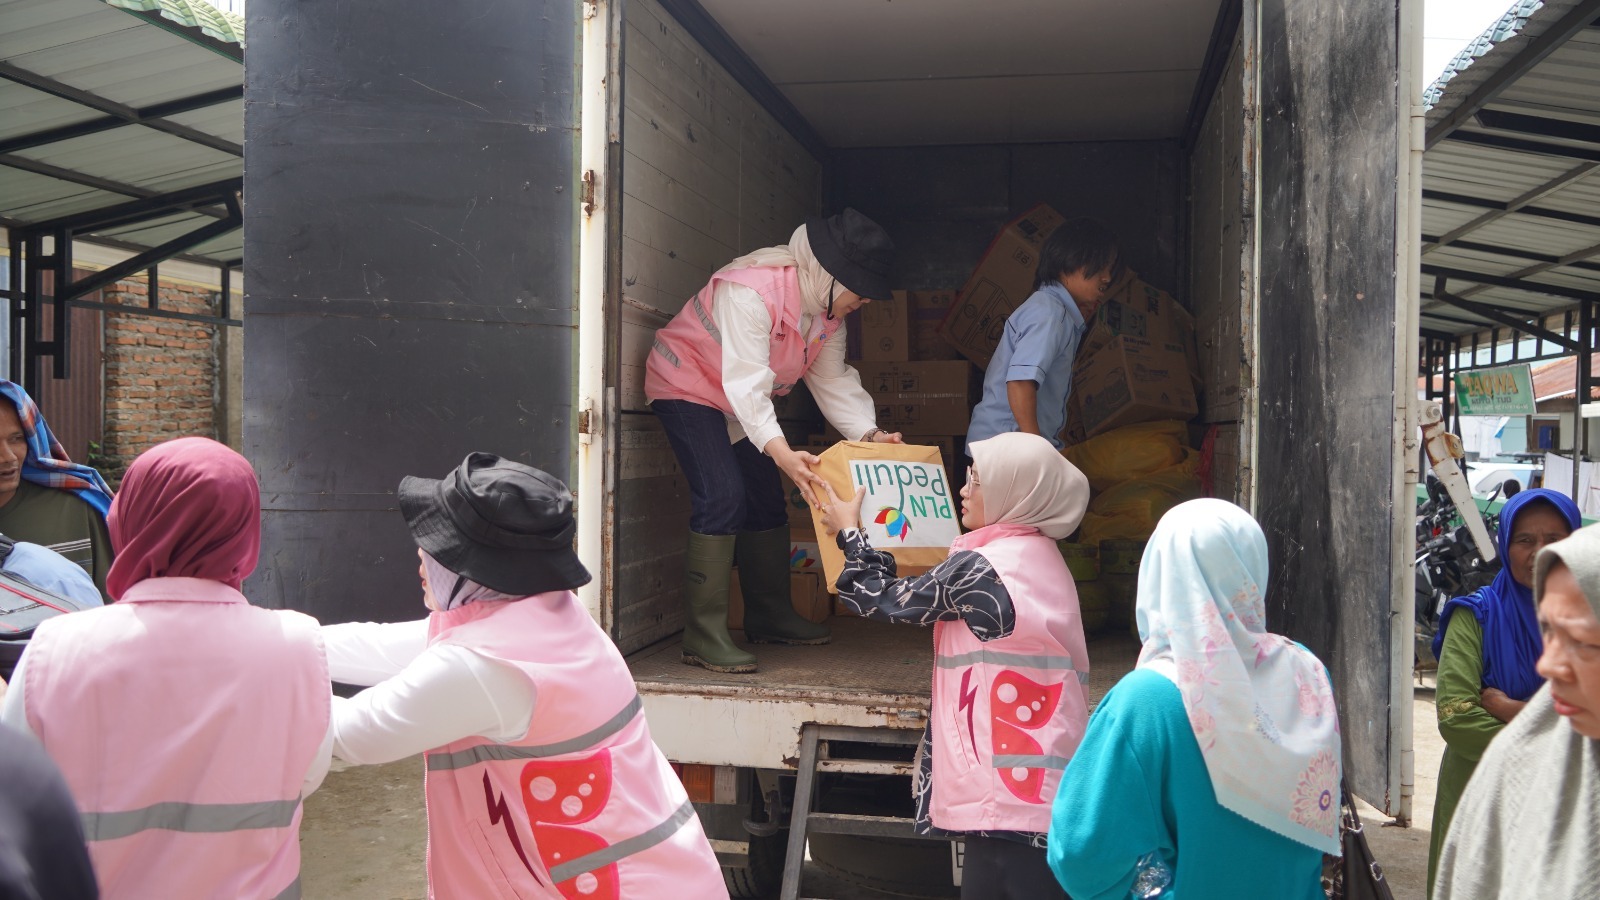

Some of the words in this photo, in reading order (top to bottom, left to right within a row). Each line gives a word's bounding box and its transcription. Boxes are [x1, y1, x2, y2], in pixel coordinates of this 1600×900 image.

[1464, 372, 1518, 398] TAQWA
[855, 463, 947, 511] Peduli
[909, 494, 953, 519] PLN
